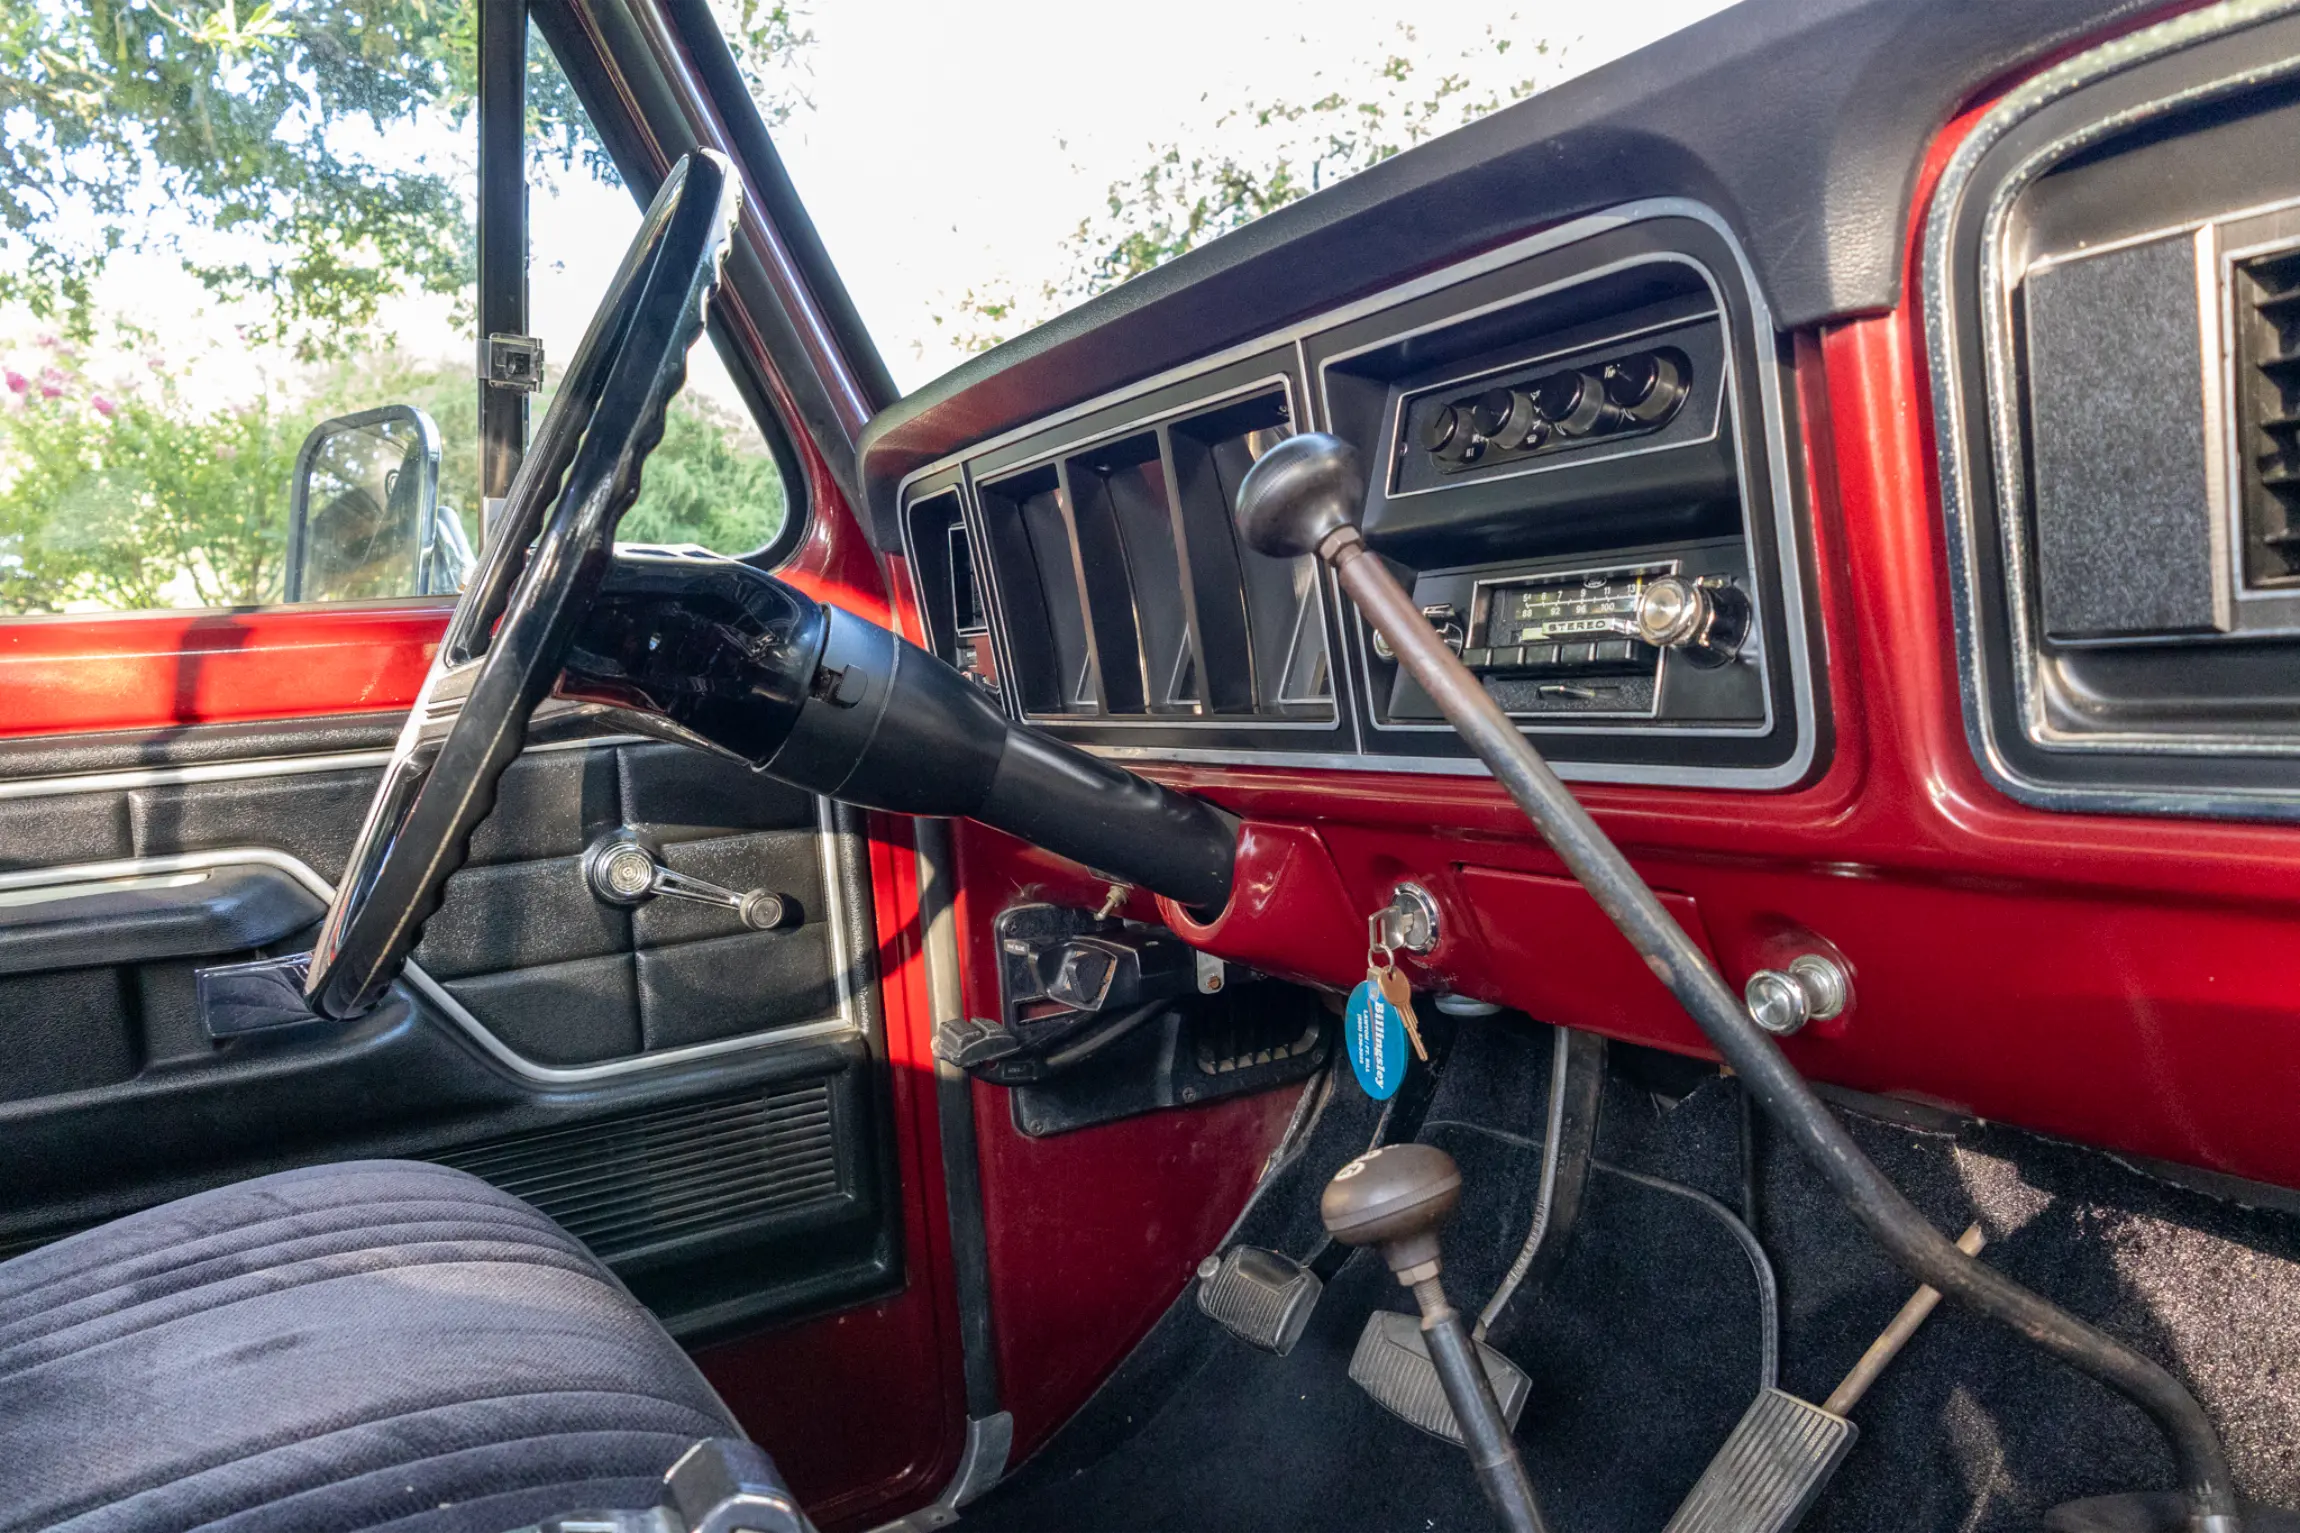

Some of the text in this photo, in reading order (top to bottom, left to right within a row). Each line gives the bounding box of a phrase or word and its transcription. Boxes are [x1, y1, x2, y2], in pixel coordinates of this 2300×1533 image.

[1541, 592, 1547, 600] 6
[1558, 590, 1563, 599] 7
[1580, 588, 1587, 597] 9
[1604, 586, 1612, 595] 11
[1627, 584, 1636, 593] 13
[1522, 602, 1615, 618] 88 92 96 100
[1548, 620, 1606, 632] STEREO
[1375, 1001, 1385, 1090] Billingsley
